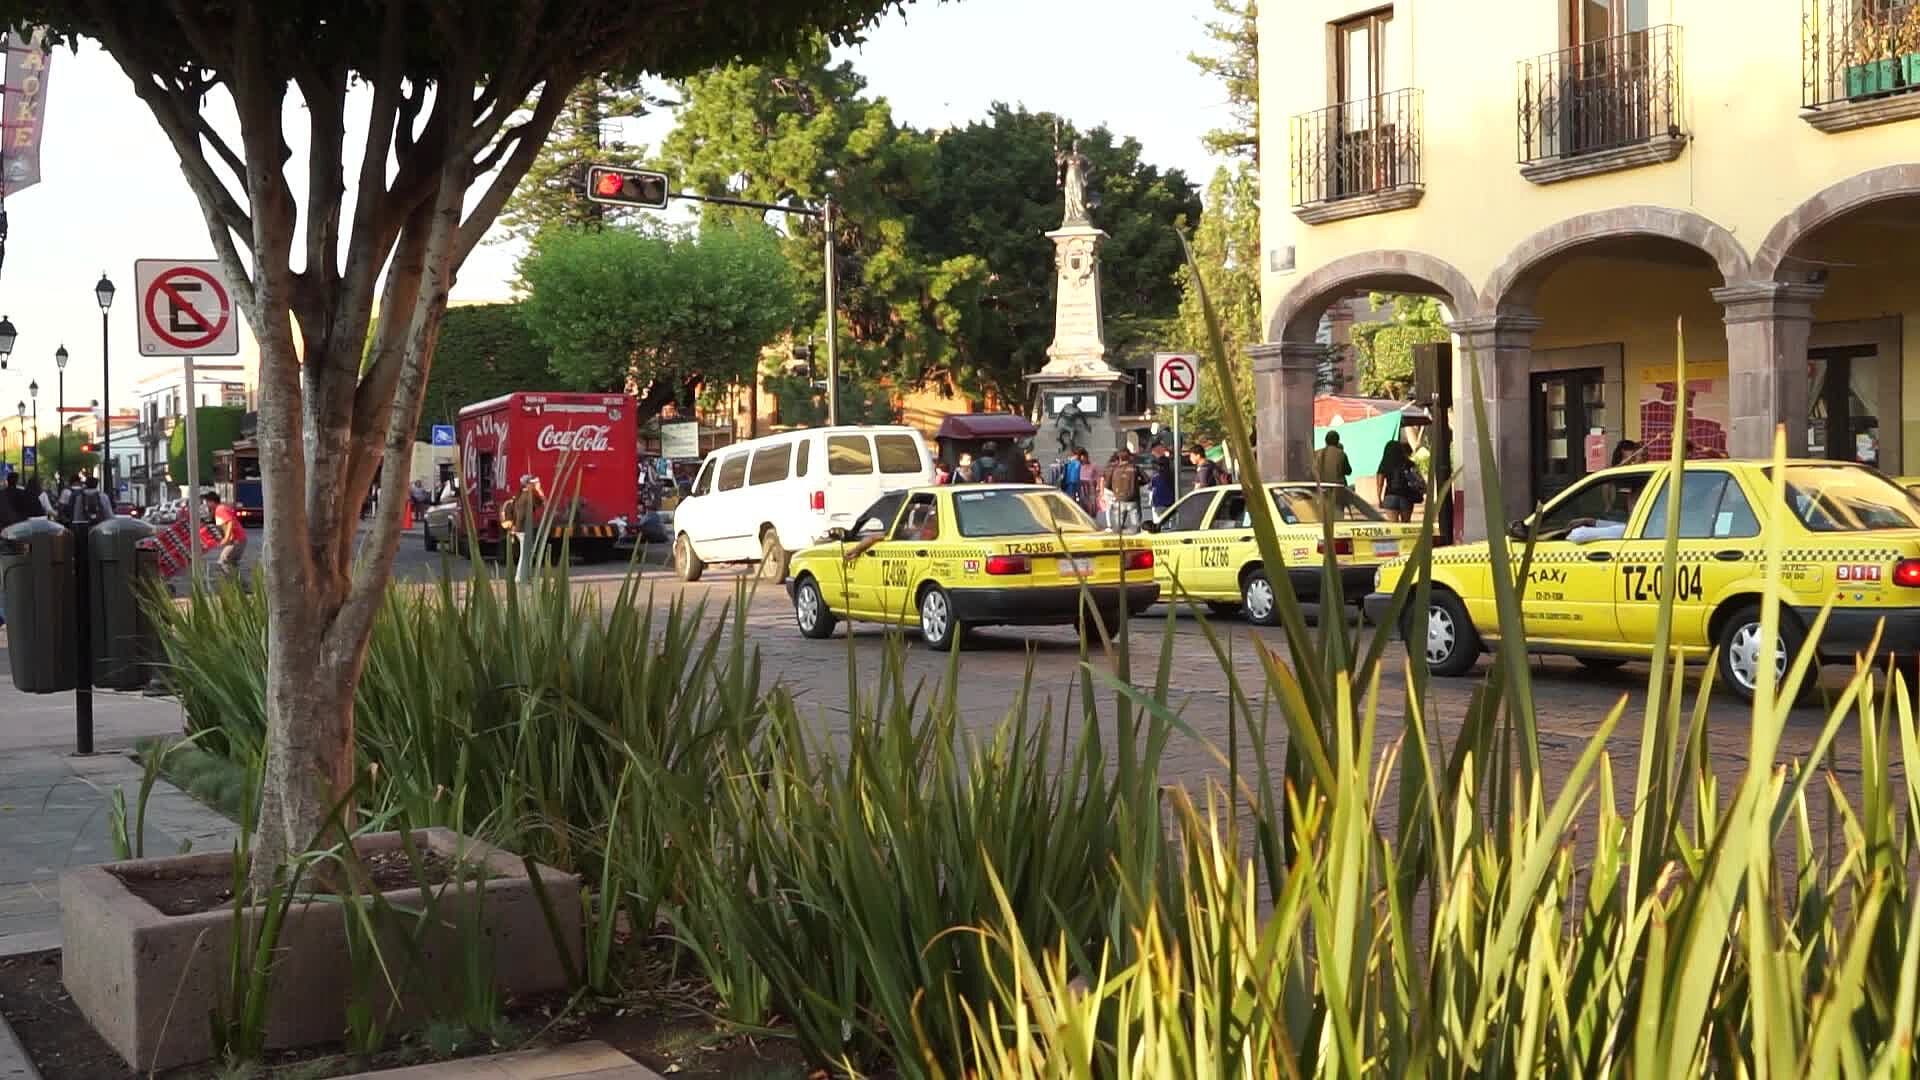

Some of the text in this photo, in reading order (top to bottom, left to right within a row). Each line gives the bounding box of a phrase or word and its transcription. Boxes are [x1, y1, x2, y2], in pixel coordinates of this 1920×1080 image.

[537, 424, 611, 451] Coca-Cola
[1005, 542, 1055, 555] TZ-0386
[1200, 546, 1229, 568] TZ-2766
[1528, 568, 1567, 584] TAXI
[1837, 565, 1880, 580] 911
[1622, 565, 1703, 601] TZ-004
